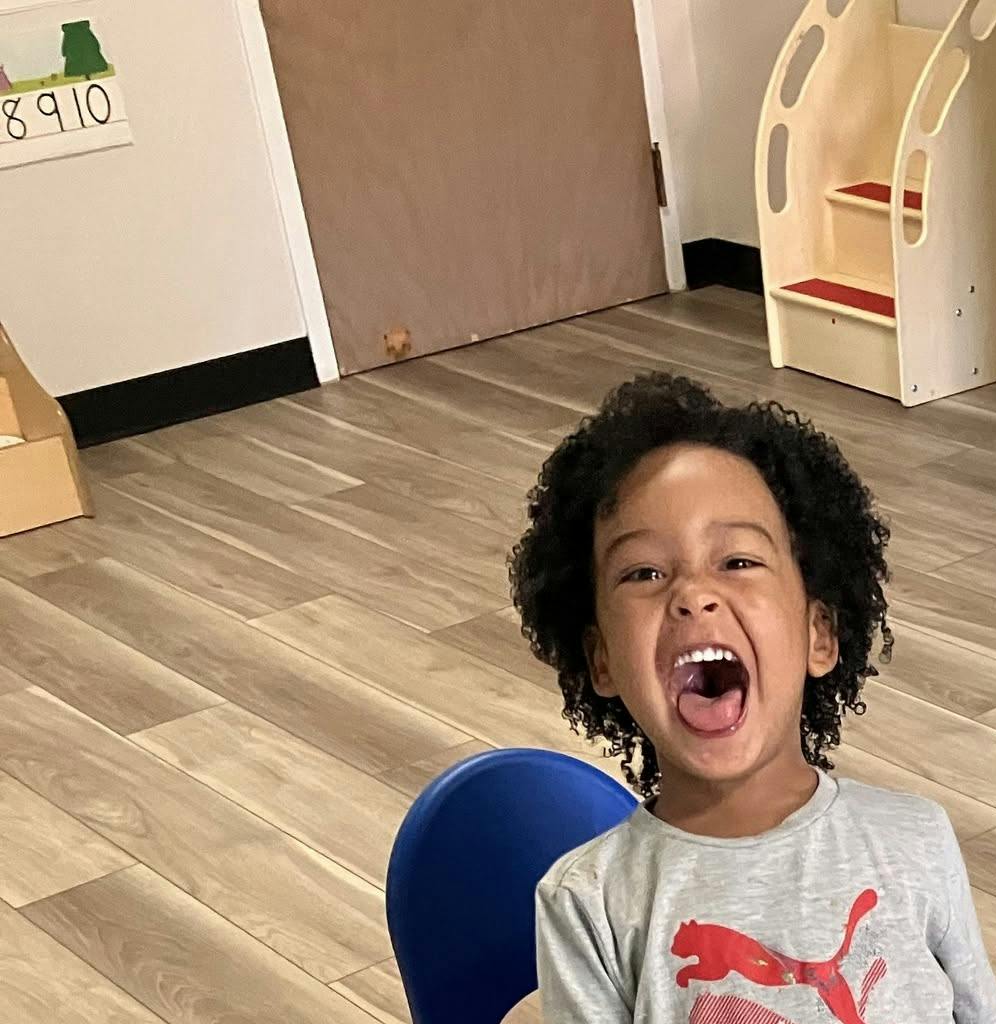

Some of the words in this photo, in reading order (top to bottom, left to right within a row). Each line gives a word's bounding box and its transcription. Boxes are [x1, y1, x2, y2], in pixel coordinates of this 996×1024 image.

[2, 96, 27, 140] 8
[37, 91, 65, 132] 9
[72, 83, 111, 128] 10
